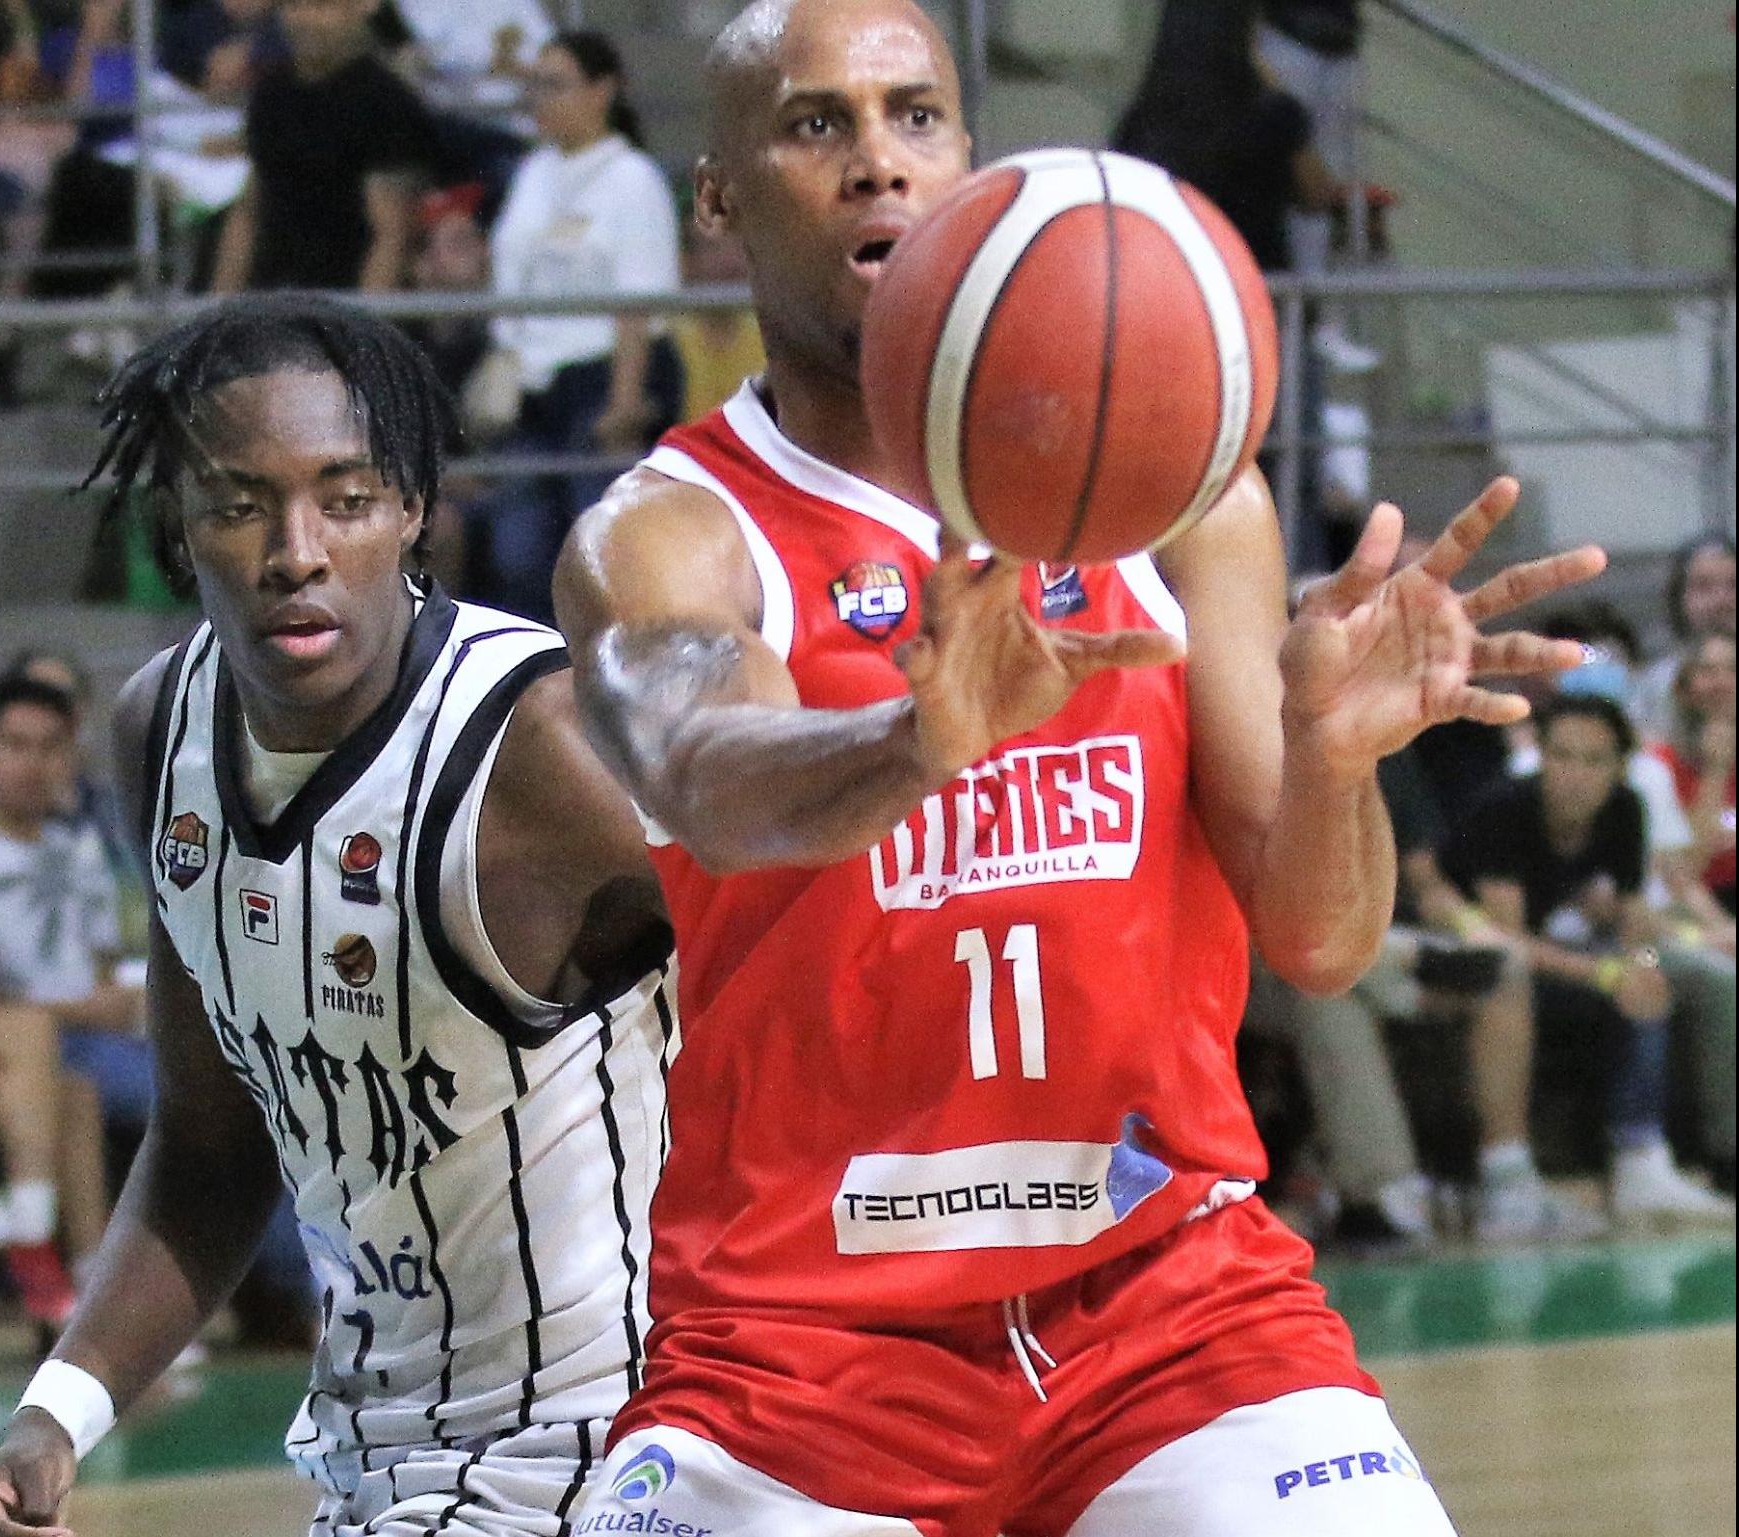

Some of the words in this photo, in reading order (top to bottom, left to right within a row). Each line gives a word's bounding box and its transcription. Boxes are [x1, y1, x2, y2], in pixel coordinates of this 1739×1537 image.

[837, 585, 908, 621] FCB
[920, 854, 1098, 900] BAANQUILLA
[322, 984, 384, 1018] PIRATAS
[954, 923, 1047, 1080] 11
[843, 1181, 1099, 1221] TECNOGLASS
[571, 1508, 712, 1537] utualser
